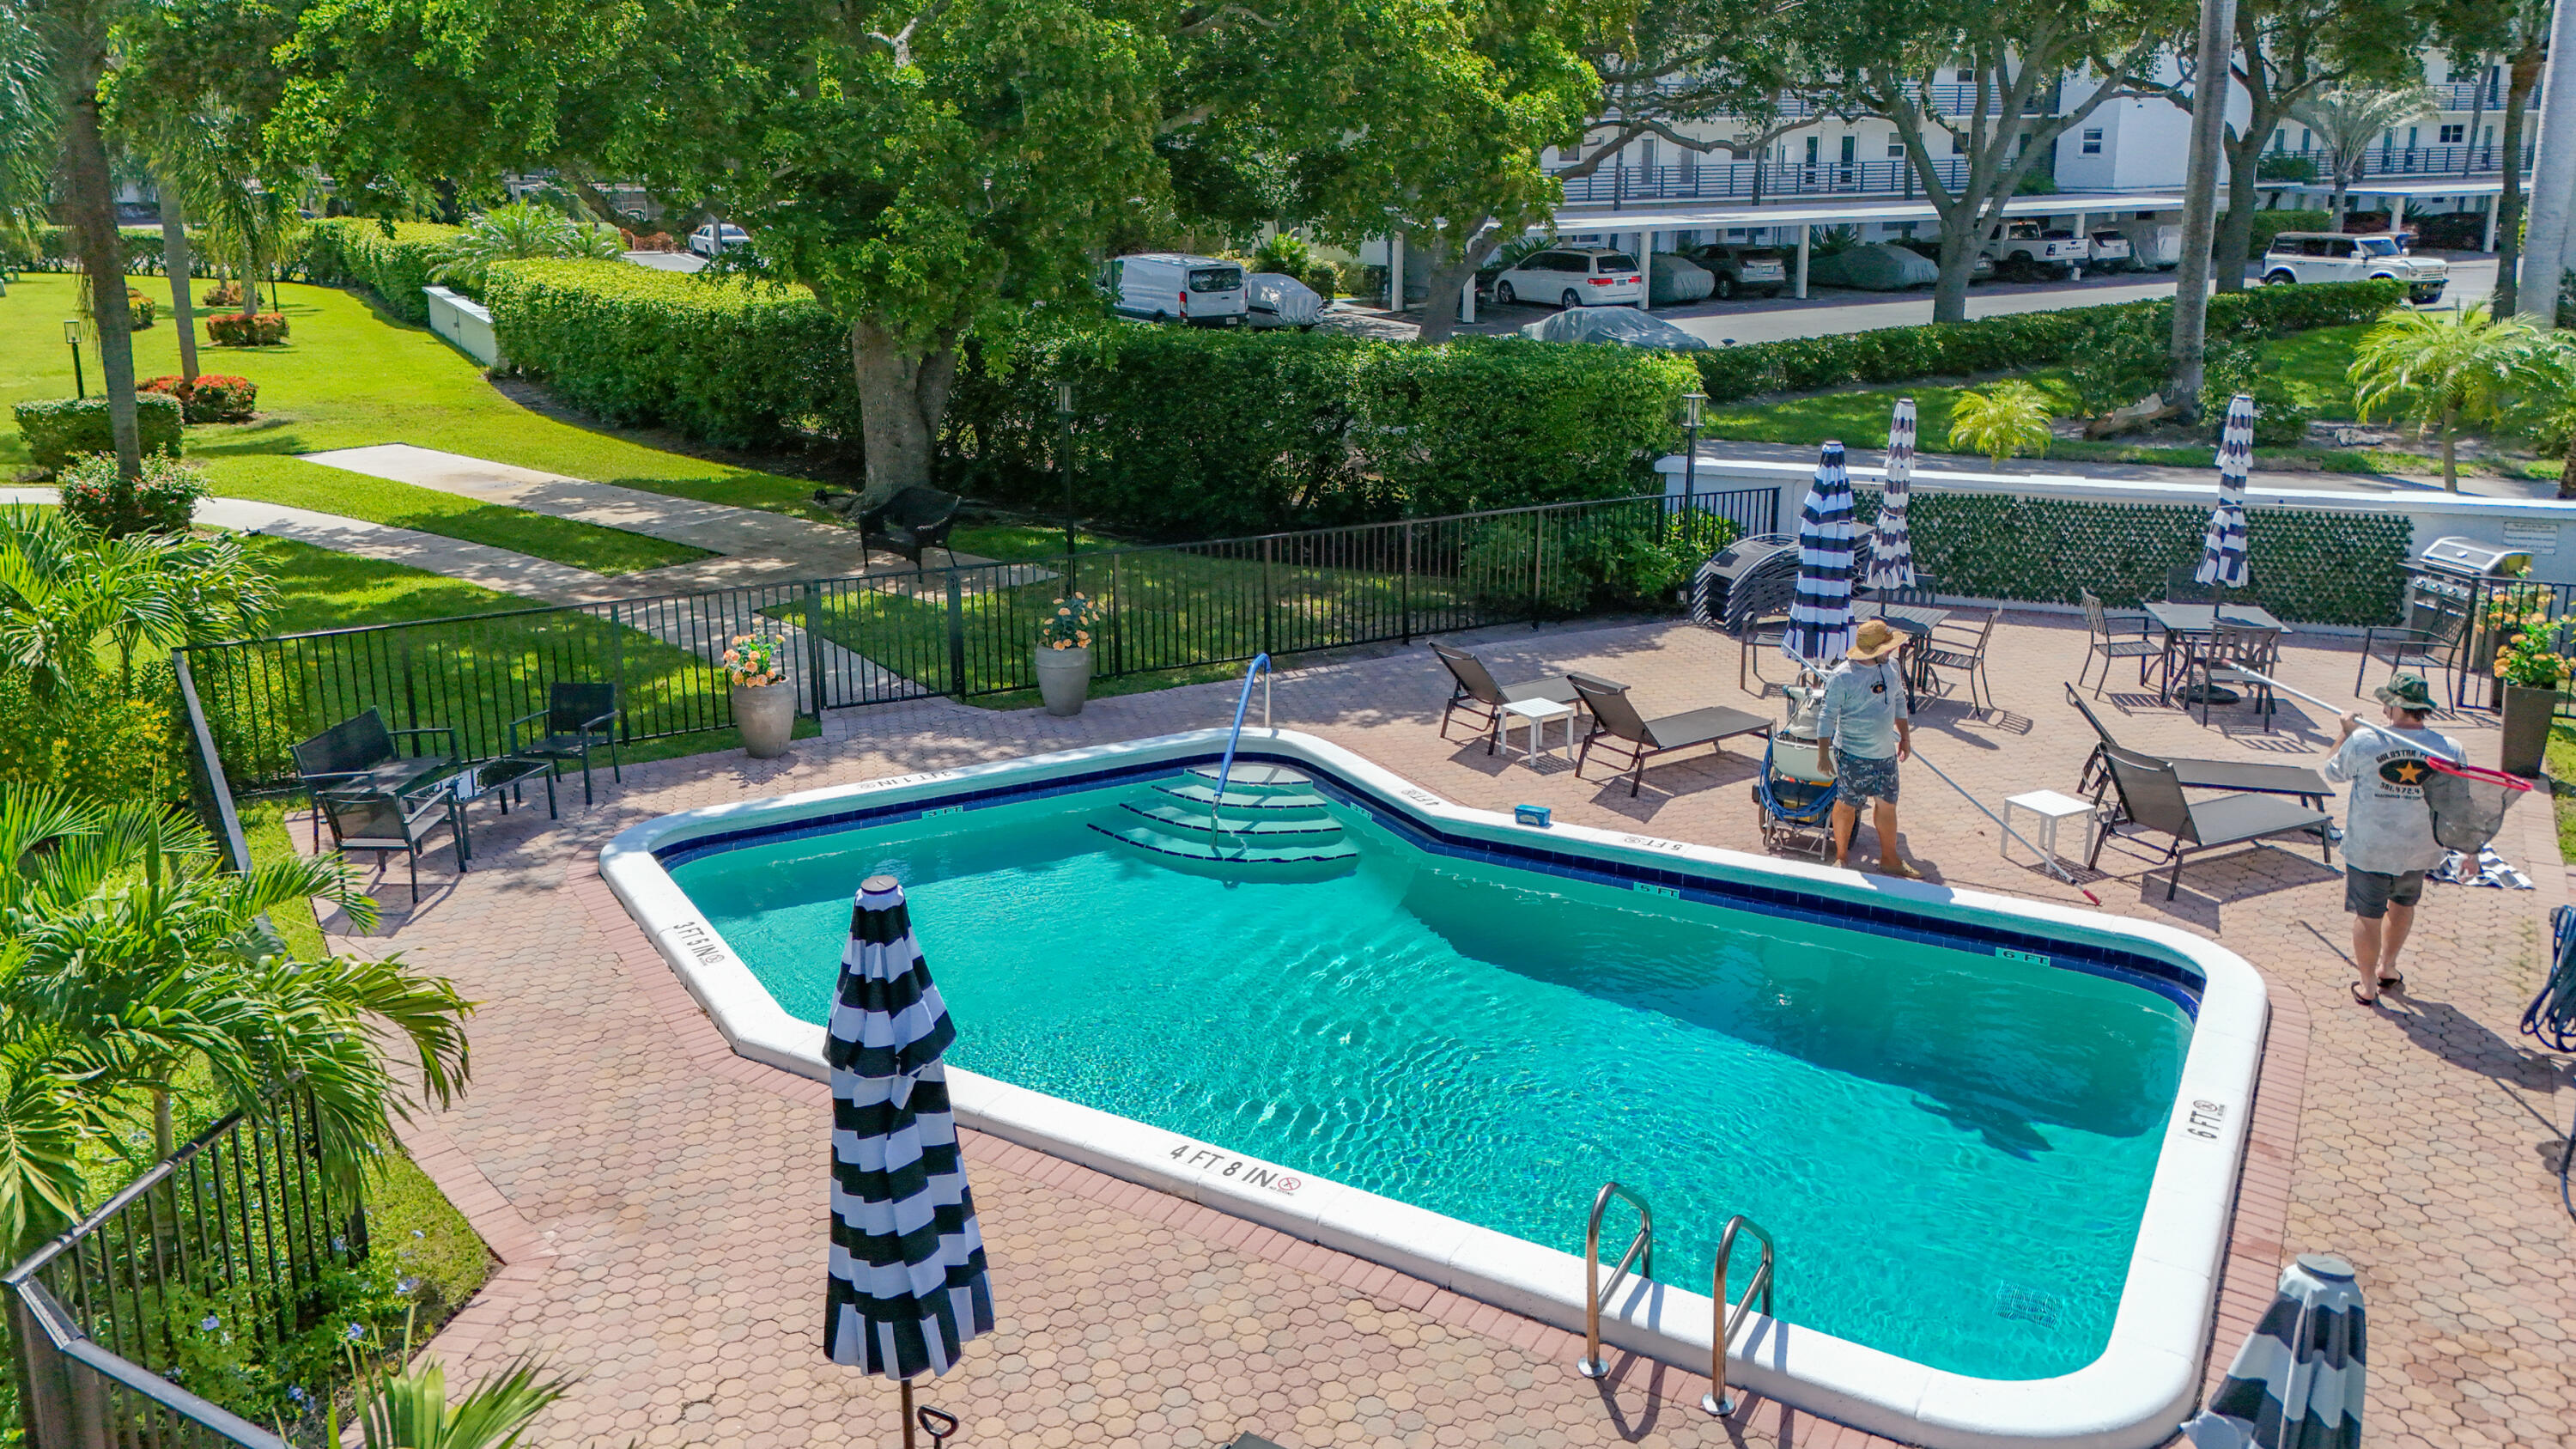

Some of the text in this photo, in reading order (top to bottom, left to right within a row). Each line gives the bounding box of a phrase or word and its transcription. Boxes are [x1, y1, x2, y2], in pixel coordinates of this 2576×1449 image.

[1643, 839, 1667, 849] FT
[1640, 884, 1650, 892] 5
[677, 928, 705, 939] FT
[691, 944, 720, 958] IN
[2002, 950, 2015, 959] 6
[2187, 1111, 2221, 1139] 6 FT
[1170, 1145, 1279, 1187] 4 FT 8 IN
